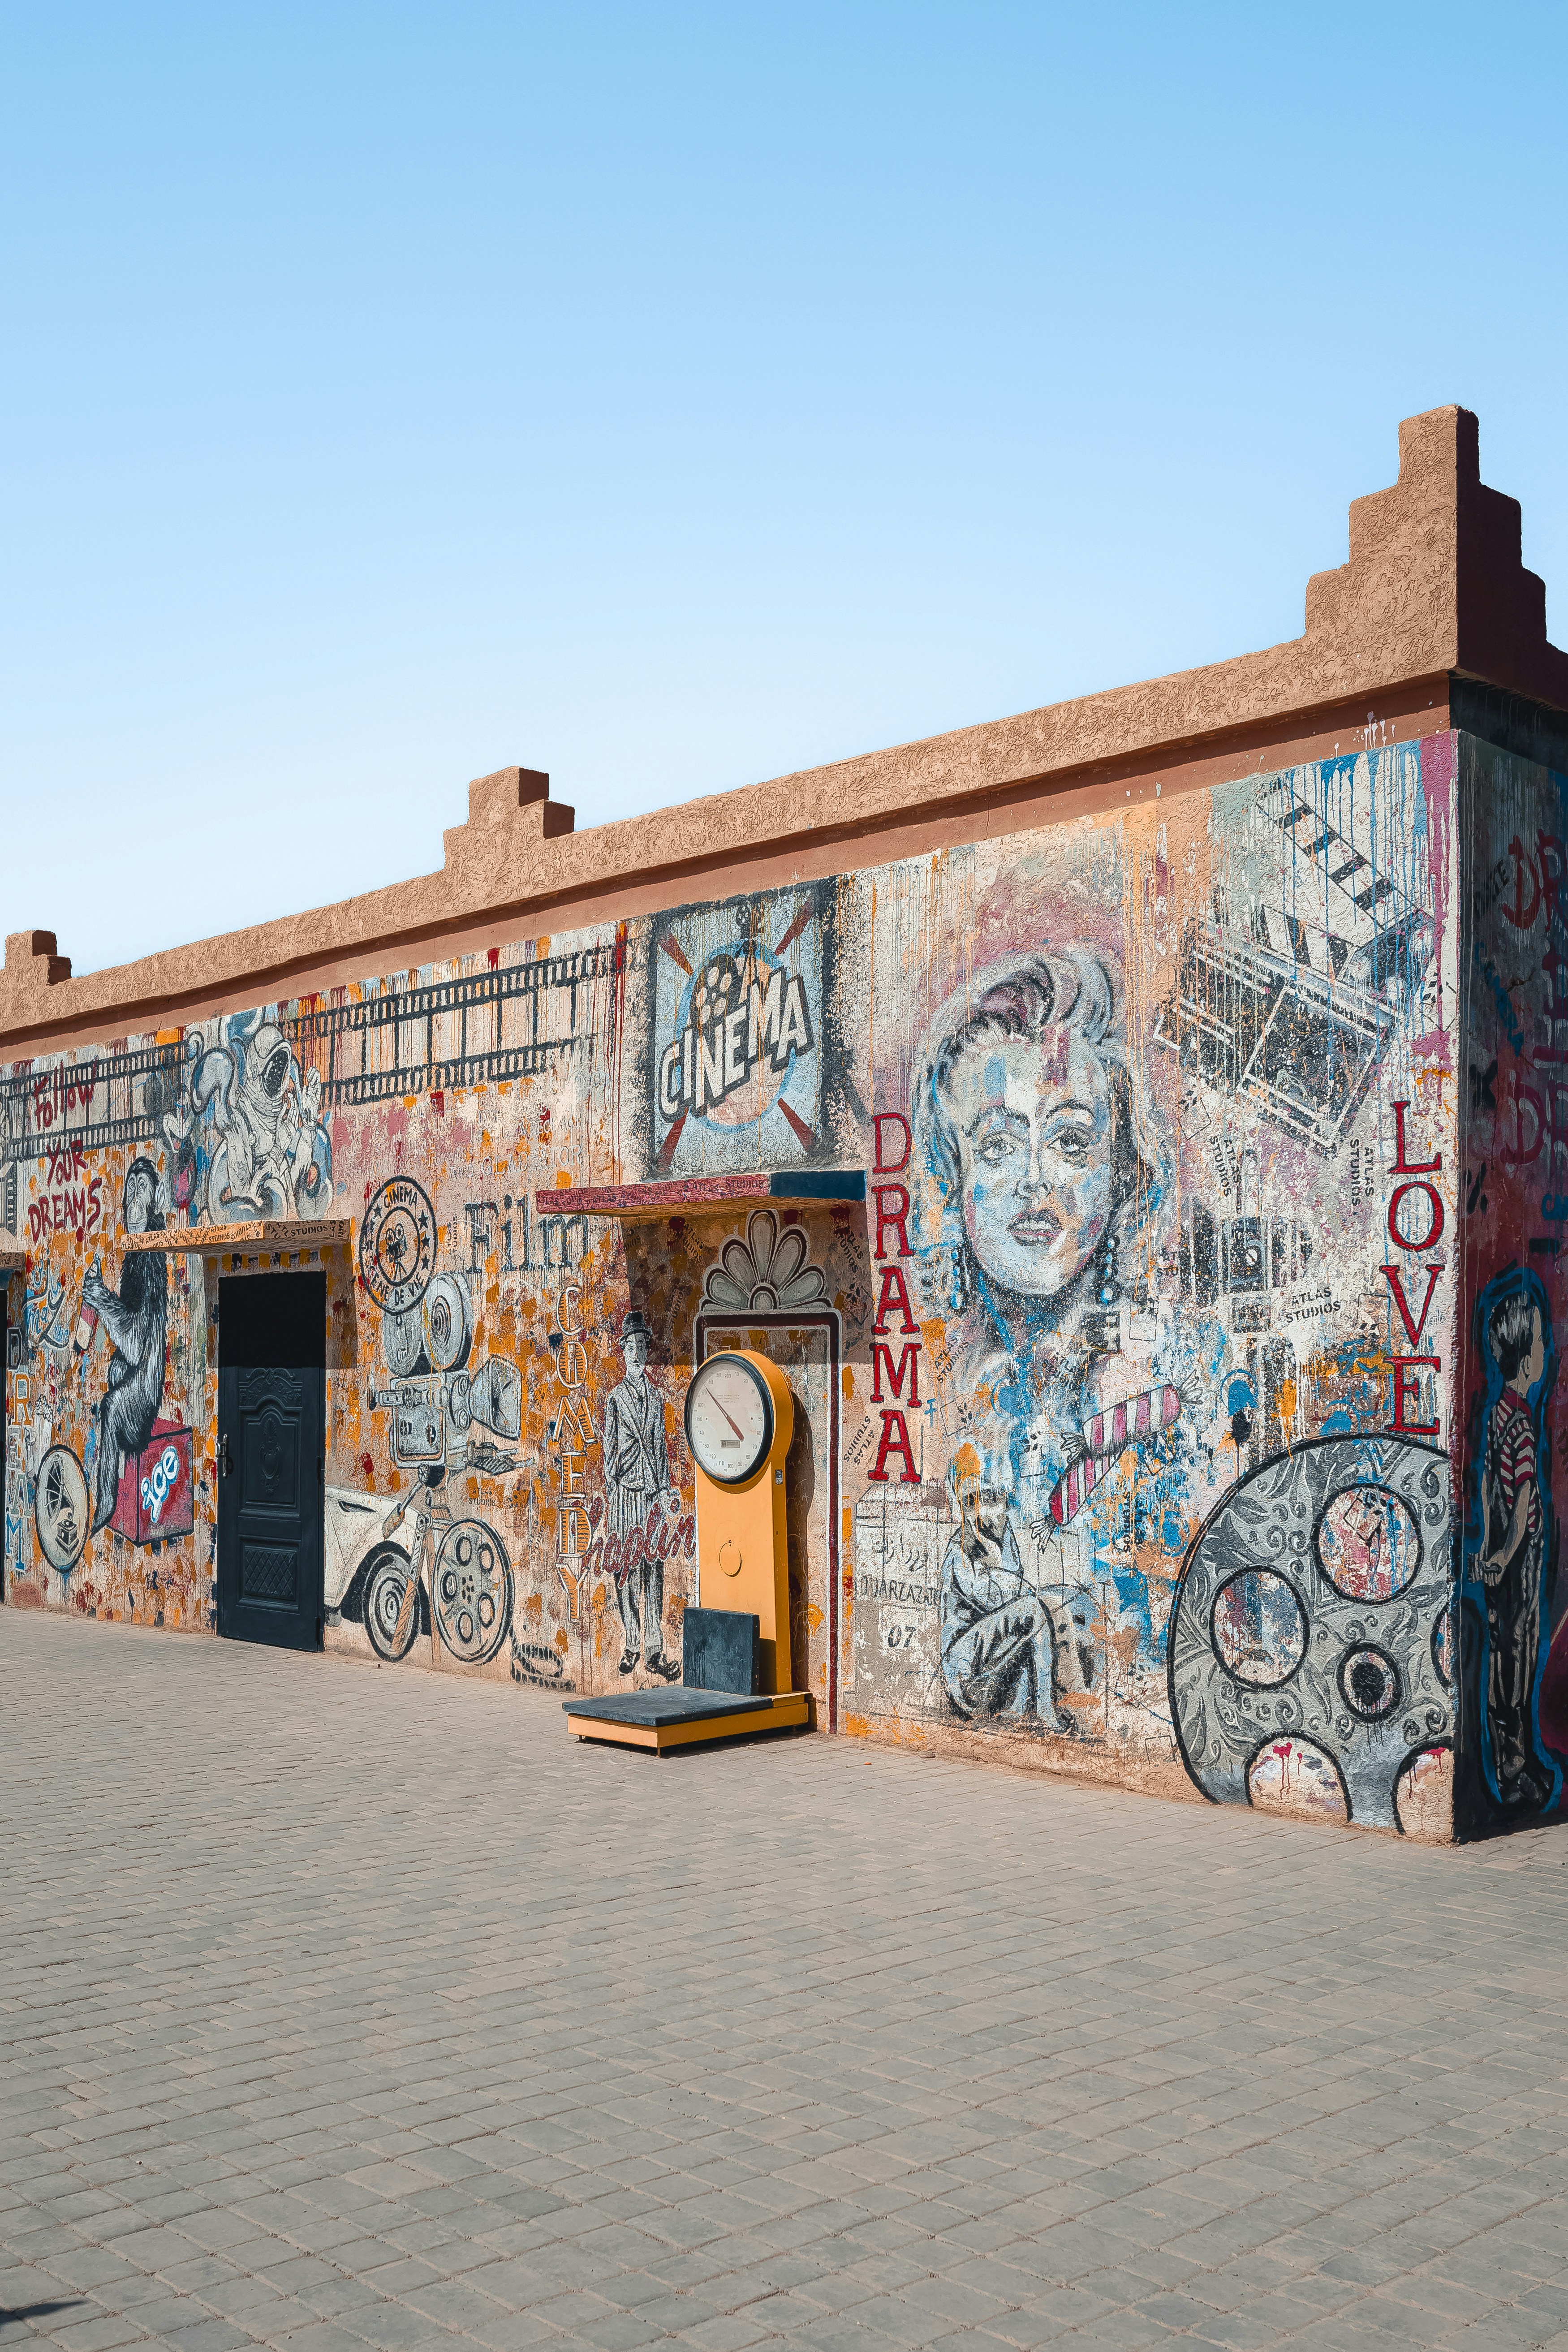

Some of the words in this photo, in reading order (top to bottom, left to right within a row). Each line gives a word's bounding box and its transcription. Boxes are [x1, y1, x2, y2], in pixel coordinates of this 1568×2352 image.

[659, 965, 814, 1121] CINEMA
[46, 1139, 88, 1186] YOUR
[482, 1144, 582, 1175] GLADTOR
[1210, 1136, 1231, 1197] STUDIOS
[1224, 1140, 1241, 1183] ATLAS
[1350, 1139, 1361, 1206] STUDIOS
[1364, 1147, 1374, 1197] ATLAS
[28, 1178, 102, 1245] DREAMS
[384, 1186, 418, 1210] CINEMA
[291, 1224, 328, 1237] STUDIOS
[682, 1234, 702, 1264] TUDIOS
[684, 1223, 704, 1249] ATLAS
[837, 1235, 859, 1273] TUDIOS
[1381, 1100, 1445, 1435] LOVE
[394, 1288, 405, 1306] DE
[408, 1272, 424, 1297] VIE
[867, 1112, 922, 1483] DRAMA
[1292, 1287, 1331, 1306] ATLAS
[1286, 1300, 1341, 1323] STUDIOS
[552, 1285, 597, 1621] COMEDY
[844, 1416, 870, 1462] STUDIOS
[854, 1430, 875, 1465] ATLAS
[469, 1498, 495, 1507] STUDIOS
[569, 1490, 696, 1589] haplin
[887, 1625, 917, 1648] 07
